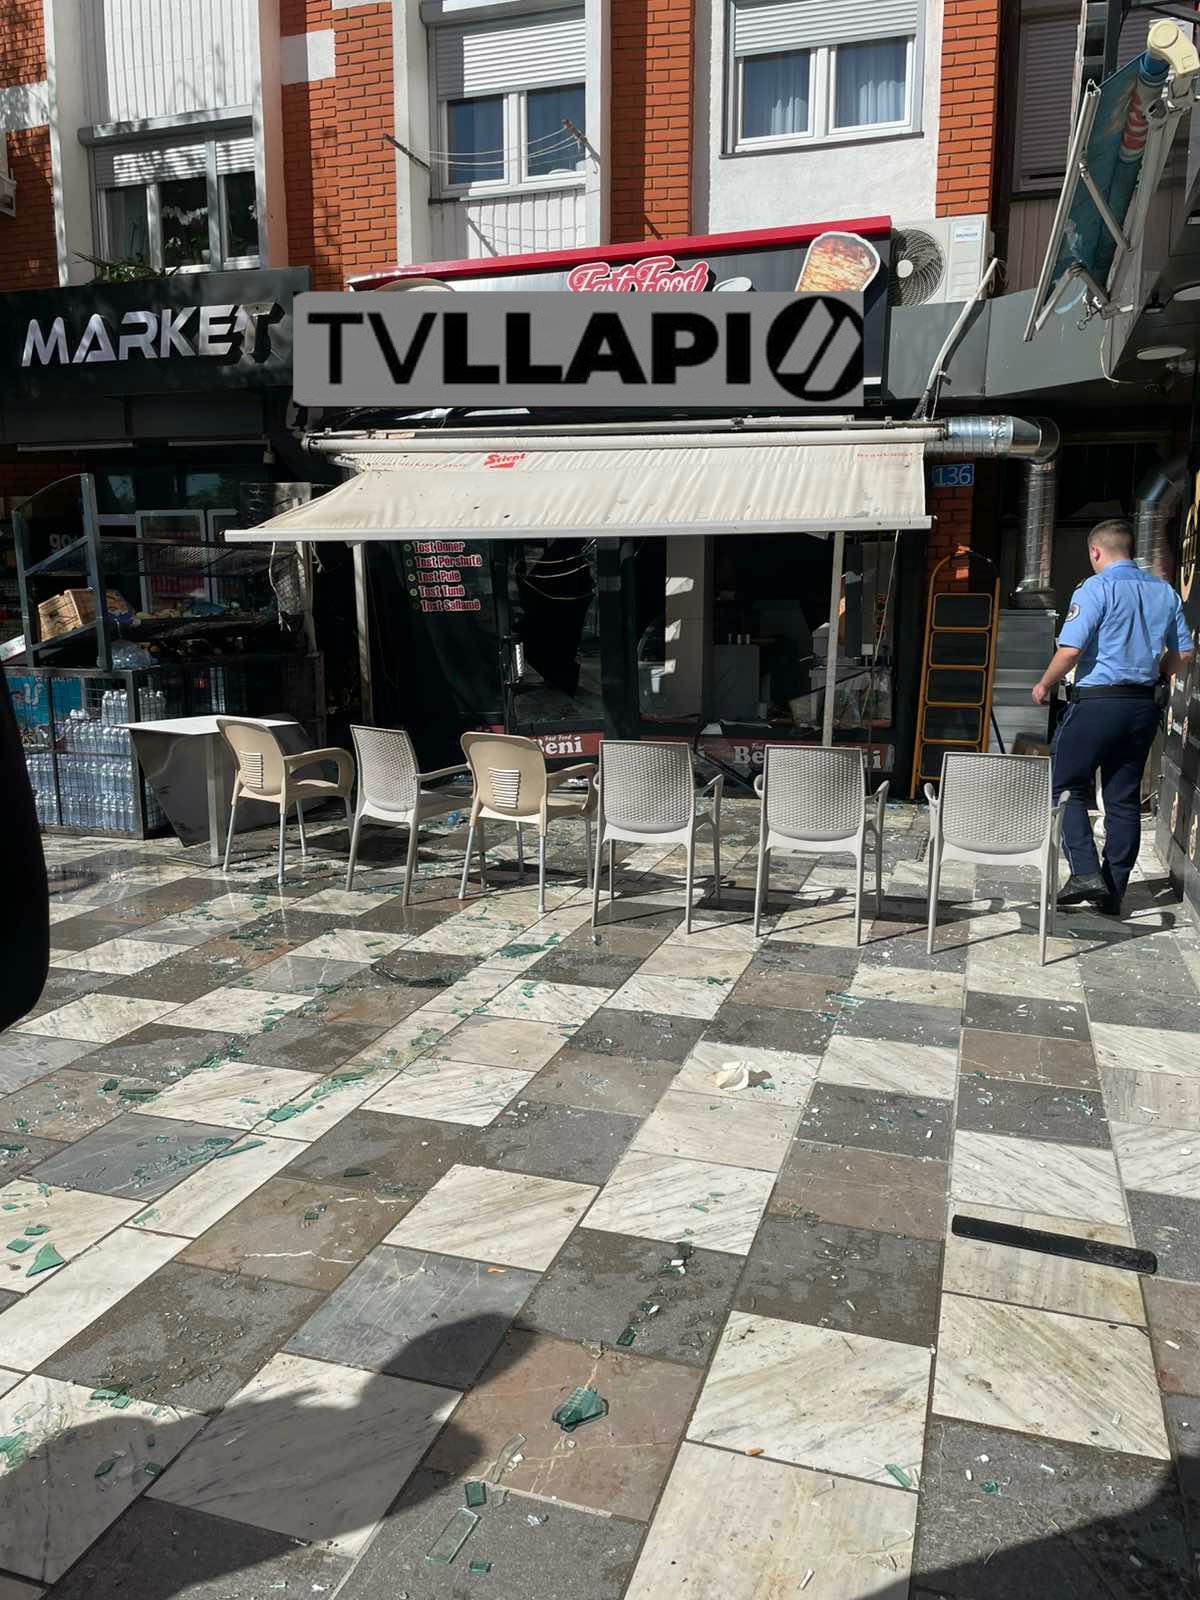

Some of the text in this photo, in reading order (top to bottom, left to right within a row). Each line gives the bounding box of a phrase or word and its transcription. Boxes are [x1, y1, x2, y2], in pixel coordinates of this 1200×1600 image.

[568, 256, 709, 291] Fast Food
[22, 301, 282, 367] MARKET
[934, 465, 971, 485] 136
[413, 541, 435, 553] Tost
[415, 556, 437, 568] Tost
[417, 571, 439, 583] Tost
[419, 585, 441, 597] Tost
[421, 600, 443, 612] Tost
